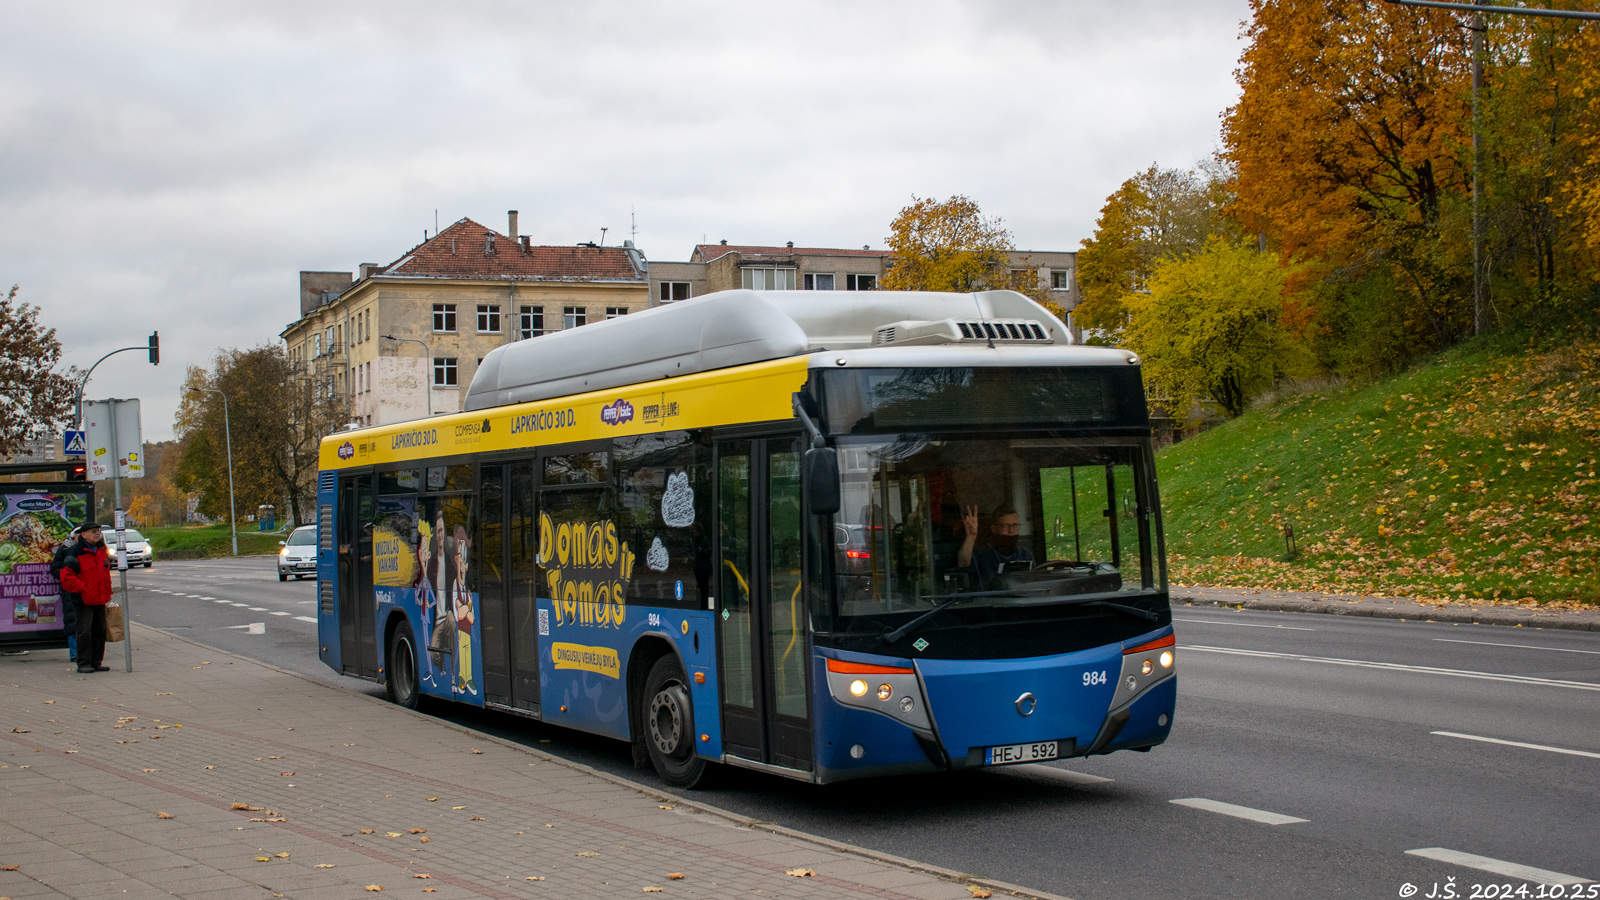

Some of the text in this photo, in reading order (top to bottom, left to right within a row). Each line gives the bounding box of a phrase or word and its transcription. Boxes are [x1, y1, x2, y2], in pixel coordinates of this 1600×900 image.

[455, 423, 481, 437] COMPENSA
[511, 408, 576, 434] LAPKRIČIO 30 D.
[392, 429, 421, 450] LAPKRIČIO
[423, 430, 431, 446] 30
[432, 429, 439, 444] D.
[538, 510, 636, 582] Domas ir
[3, 584, 61, 597] MAKARONU
[547, 565, 627, 630] Tomas
[648, 613, 660, 627] 984
[557, 648, 617, 669] DINGUSIŲ VEIKĖJŲ BYLA
[1082, 671, 1107, 686] 984
[993, 743, 1055, 762] HEJ 592
